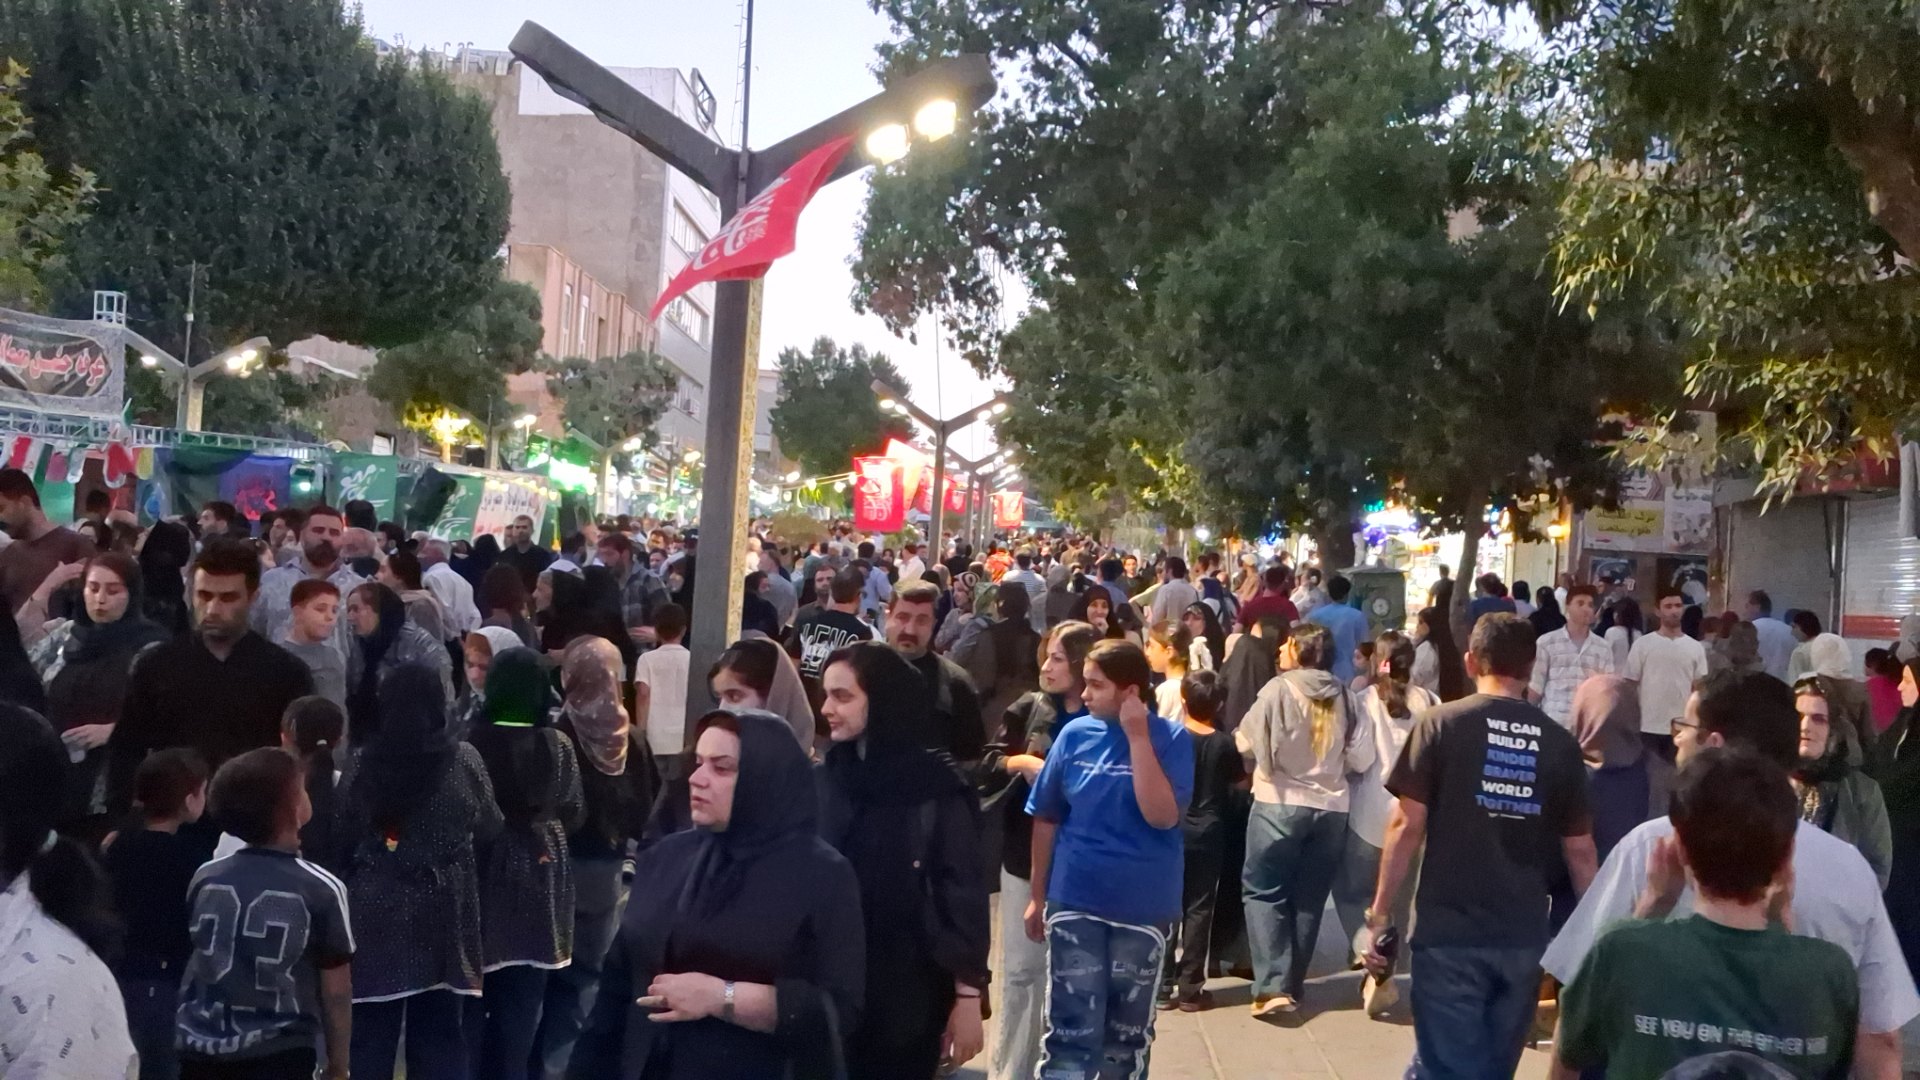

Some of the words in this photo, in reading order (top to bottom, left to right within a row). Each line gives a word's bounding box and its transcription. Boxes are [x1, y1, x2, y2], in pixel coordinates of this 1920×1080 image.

[1486, 718, 1508, 732] WE
[1510, 722, 1541, 736] CAN
[1487, 733, 1527, 750] BUILD
[1528, 740, 1540, 752] A
[1486, 749, 1537, 767] KINDER
[1483, 765, 1537, 782] BRAVER
[1481, 780, 1533, 798] WORLD
[1634, 1014, 1658, 1036] SEE
[1661, 1018, 1696, 1040] YOU
[1697, 1023, 1723, 1043] ON
